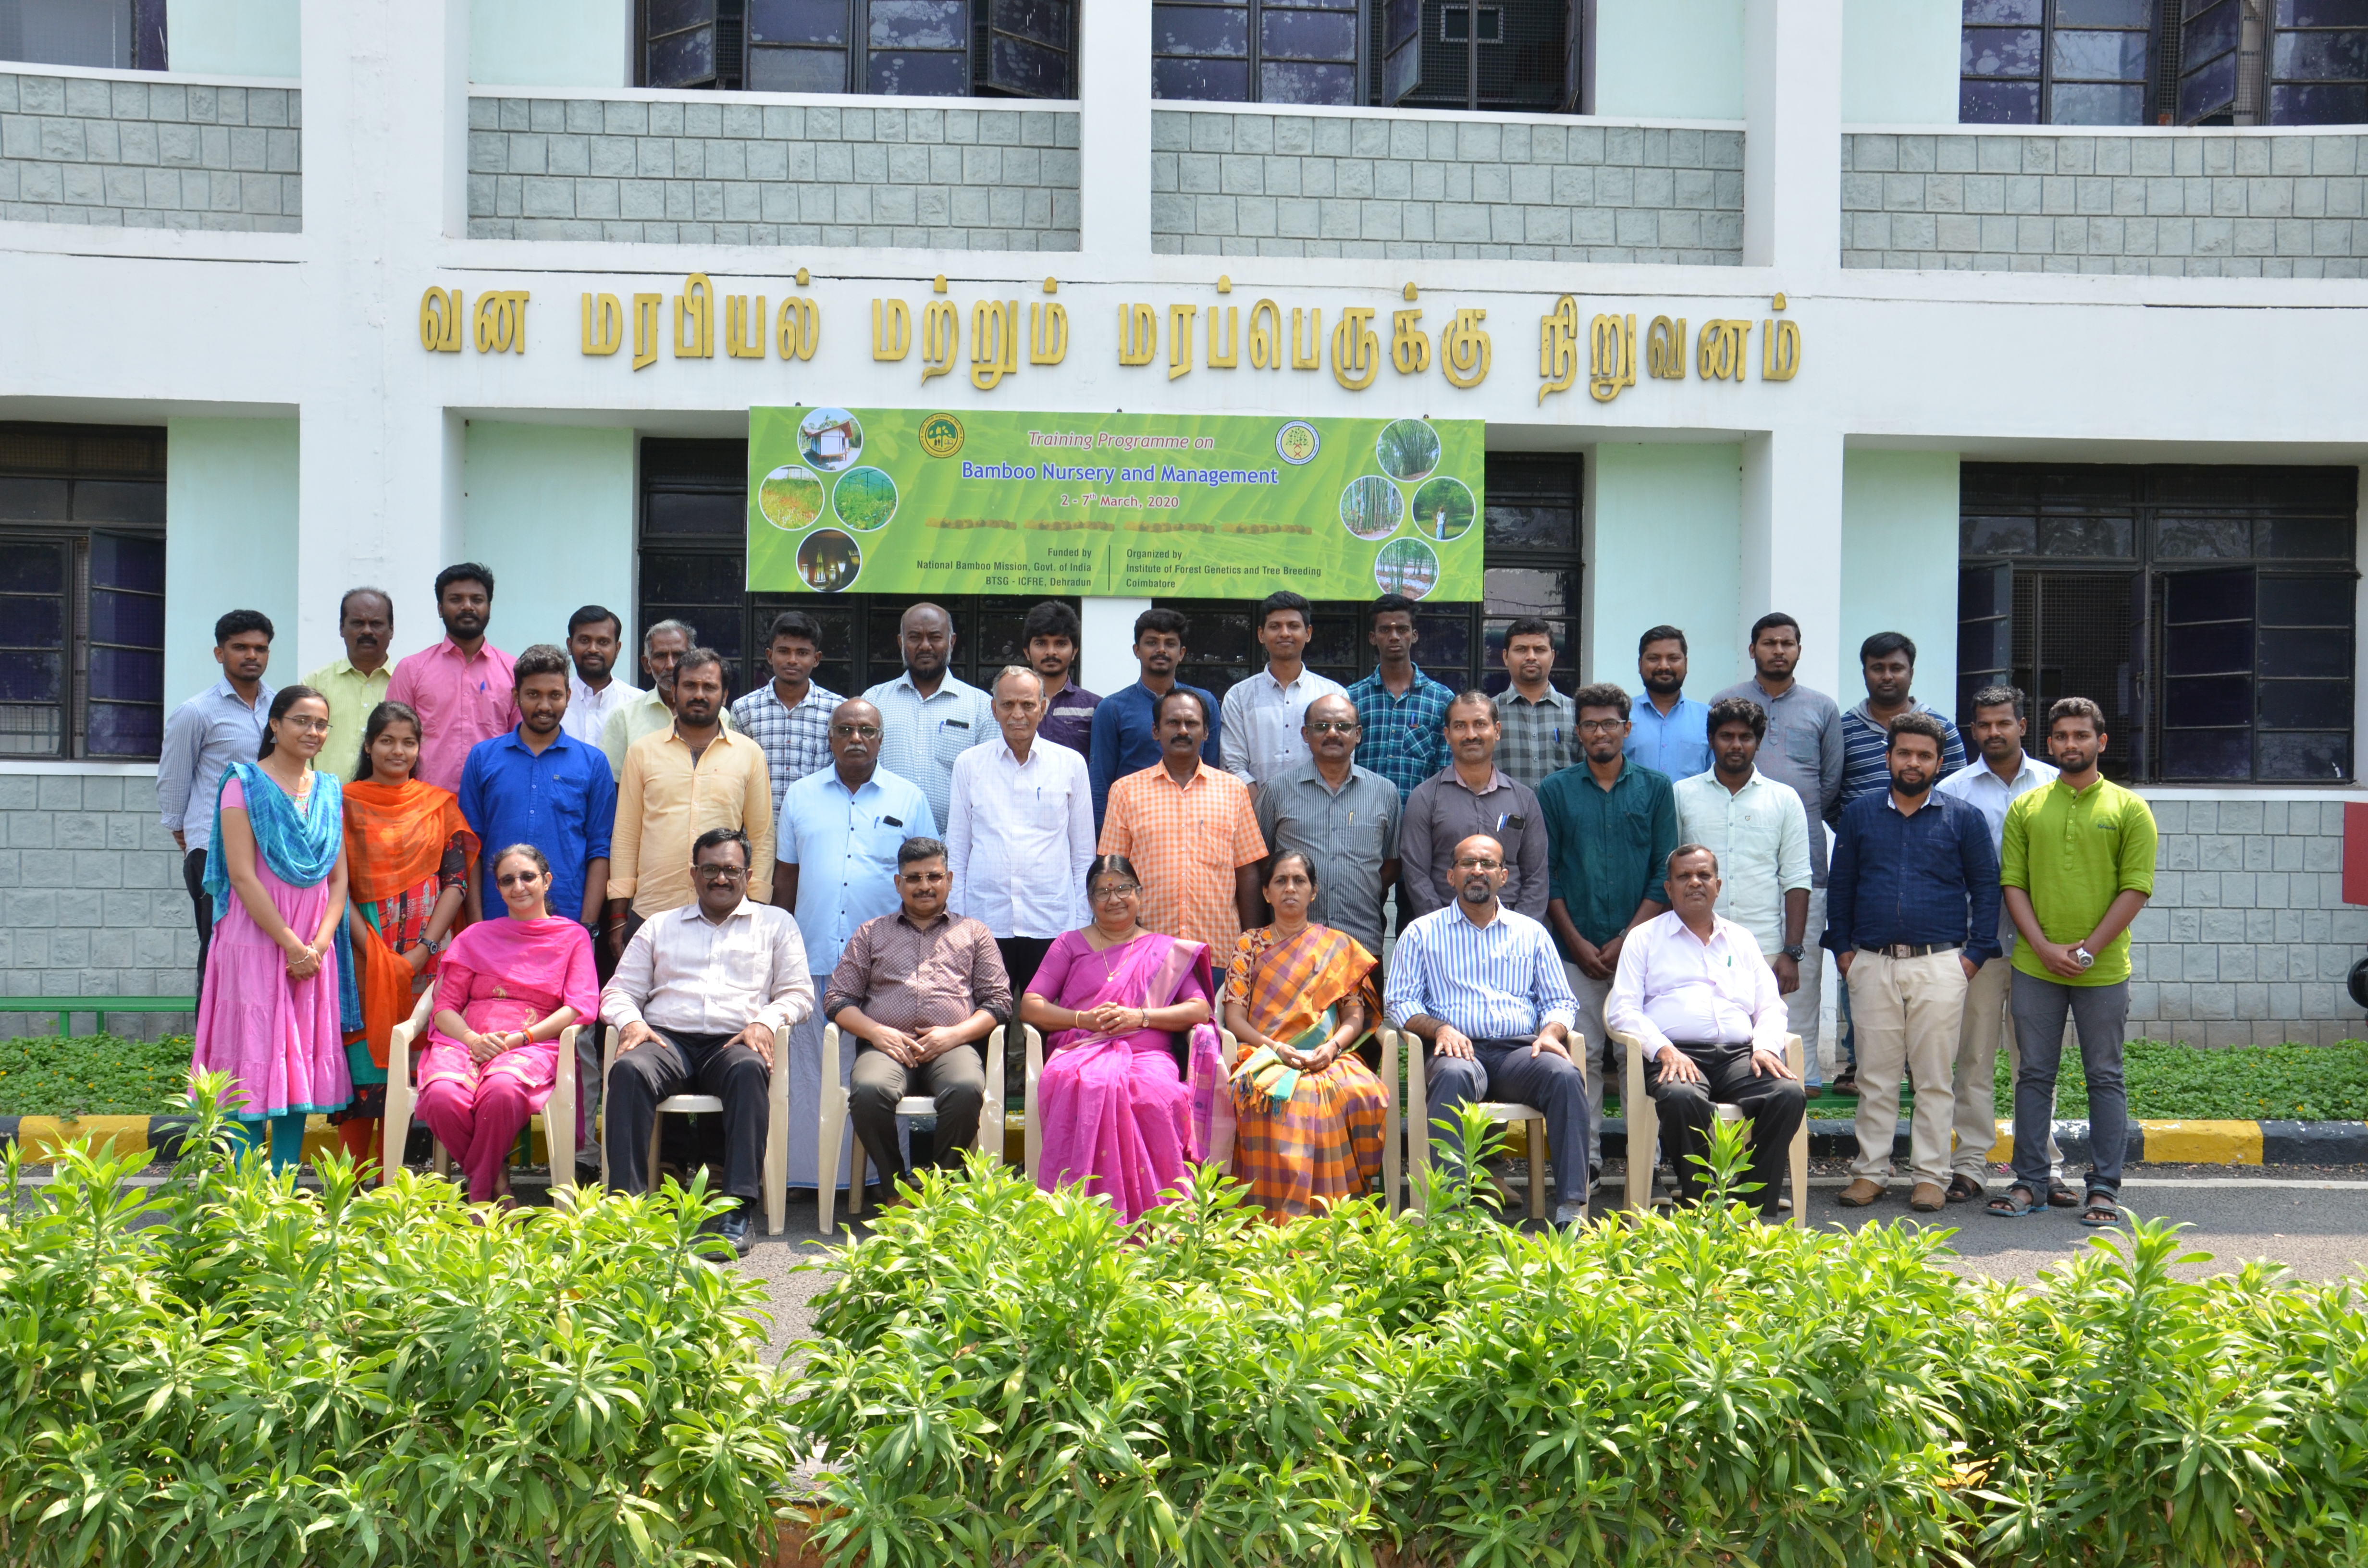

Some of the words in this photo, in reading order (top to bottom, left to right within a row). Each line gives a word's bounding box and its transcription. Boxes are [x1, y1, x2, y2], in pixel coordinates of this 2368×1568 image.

[581, 267, 820, 372] மரபியல்
[872, 274, 1069, 390] மற்றும்
[1118, 274, 1492, 391] மரப்பெருக்கு
[1538, 292, 1801, 407] நிறுவனம்
[1028, 431, 1092, 450] Training
[1098, 432, 1189, 451] Programme
[1194, 437, 1214, 449] on
[962, 462, 1036, 480] Bamboo
[1042, 463, 1115, 484] Nursery
[1121, 464, 1154, 481] and
[1160, 466, 1279, 486] Management
[1061, 495, 1069, 505] 2
[1100, 495, 1143, 508] March,
[1147, 496, 1179, 508] 2020
[1048, 548, 1079, 557] Funded
[1082, 548, 1092, 559] by
[1126, 549, 1170, 560] Organized
[1172, 549, 1182, 560] by
[917, 560, 953, 569] National
[956, 561, 991, 570] Bamboo
[994, 561, 1031, 572] Mission,
[1034, 562, 1056, 572] Govt.
[1059, 562, 1068, 572] of
[1070, 562, 1091, 572] India
[1126, 564, 1161, 573] Institute
[1164, 564, 1172, 574] of
[1175, 565, 1202, 574] Forest
[1204, 565, 1241, 575] Genetics
[1244, 566, 1259, 575] and
[1262, 566, 1280, 575] Tree
[1283, 566, 1321, 577] Breeding
[986, 576, 1009, 585] BTSG
[1018, 577, 1047, 588] ICFRE,
[1050, 577, 1091, 587] Dehradun
[1126, 578, 1176, 588] Coimbatore
